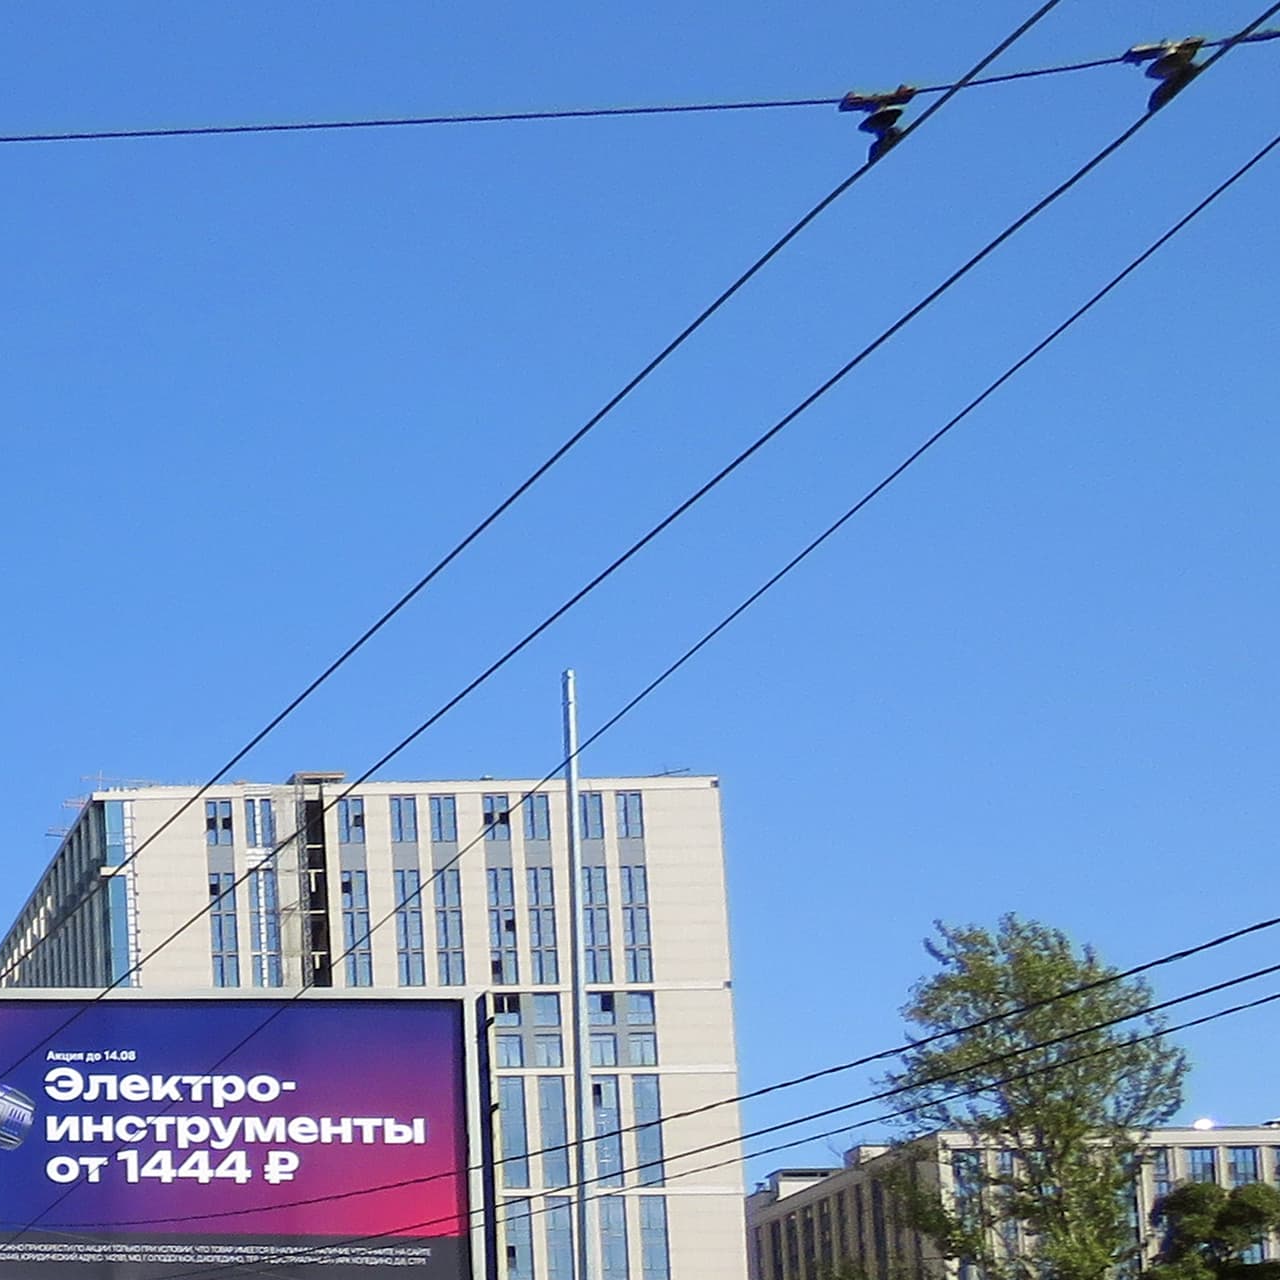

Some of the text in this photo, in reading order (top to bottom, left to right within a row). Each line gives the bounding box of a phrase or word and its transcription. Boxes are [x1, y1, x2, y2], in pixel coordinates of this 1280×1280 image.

[46, 1050, 137, 1063] Акция до 14.08
[44, 1067, 298, 1108] Электро-
[45, 1115, 427, 1149] инструменты
[45, 1149, 300, 1184] от 1444 ₽
